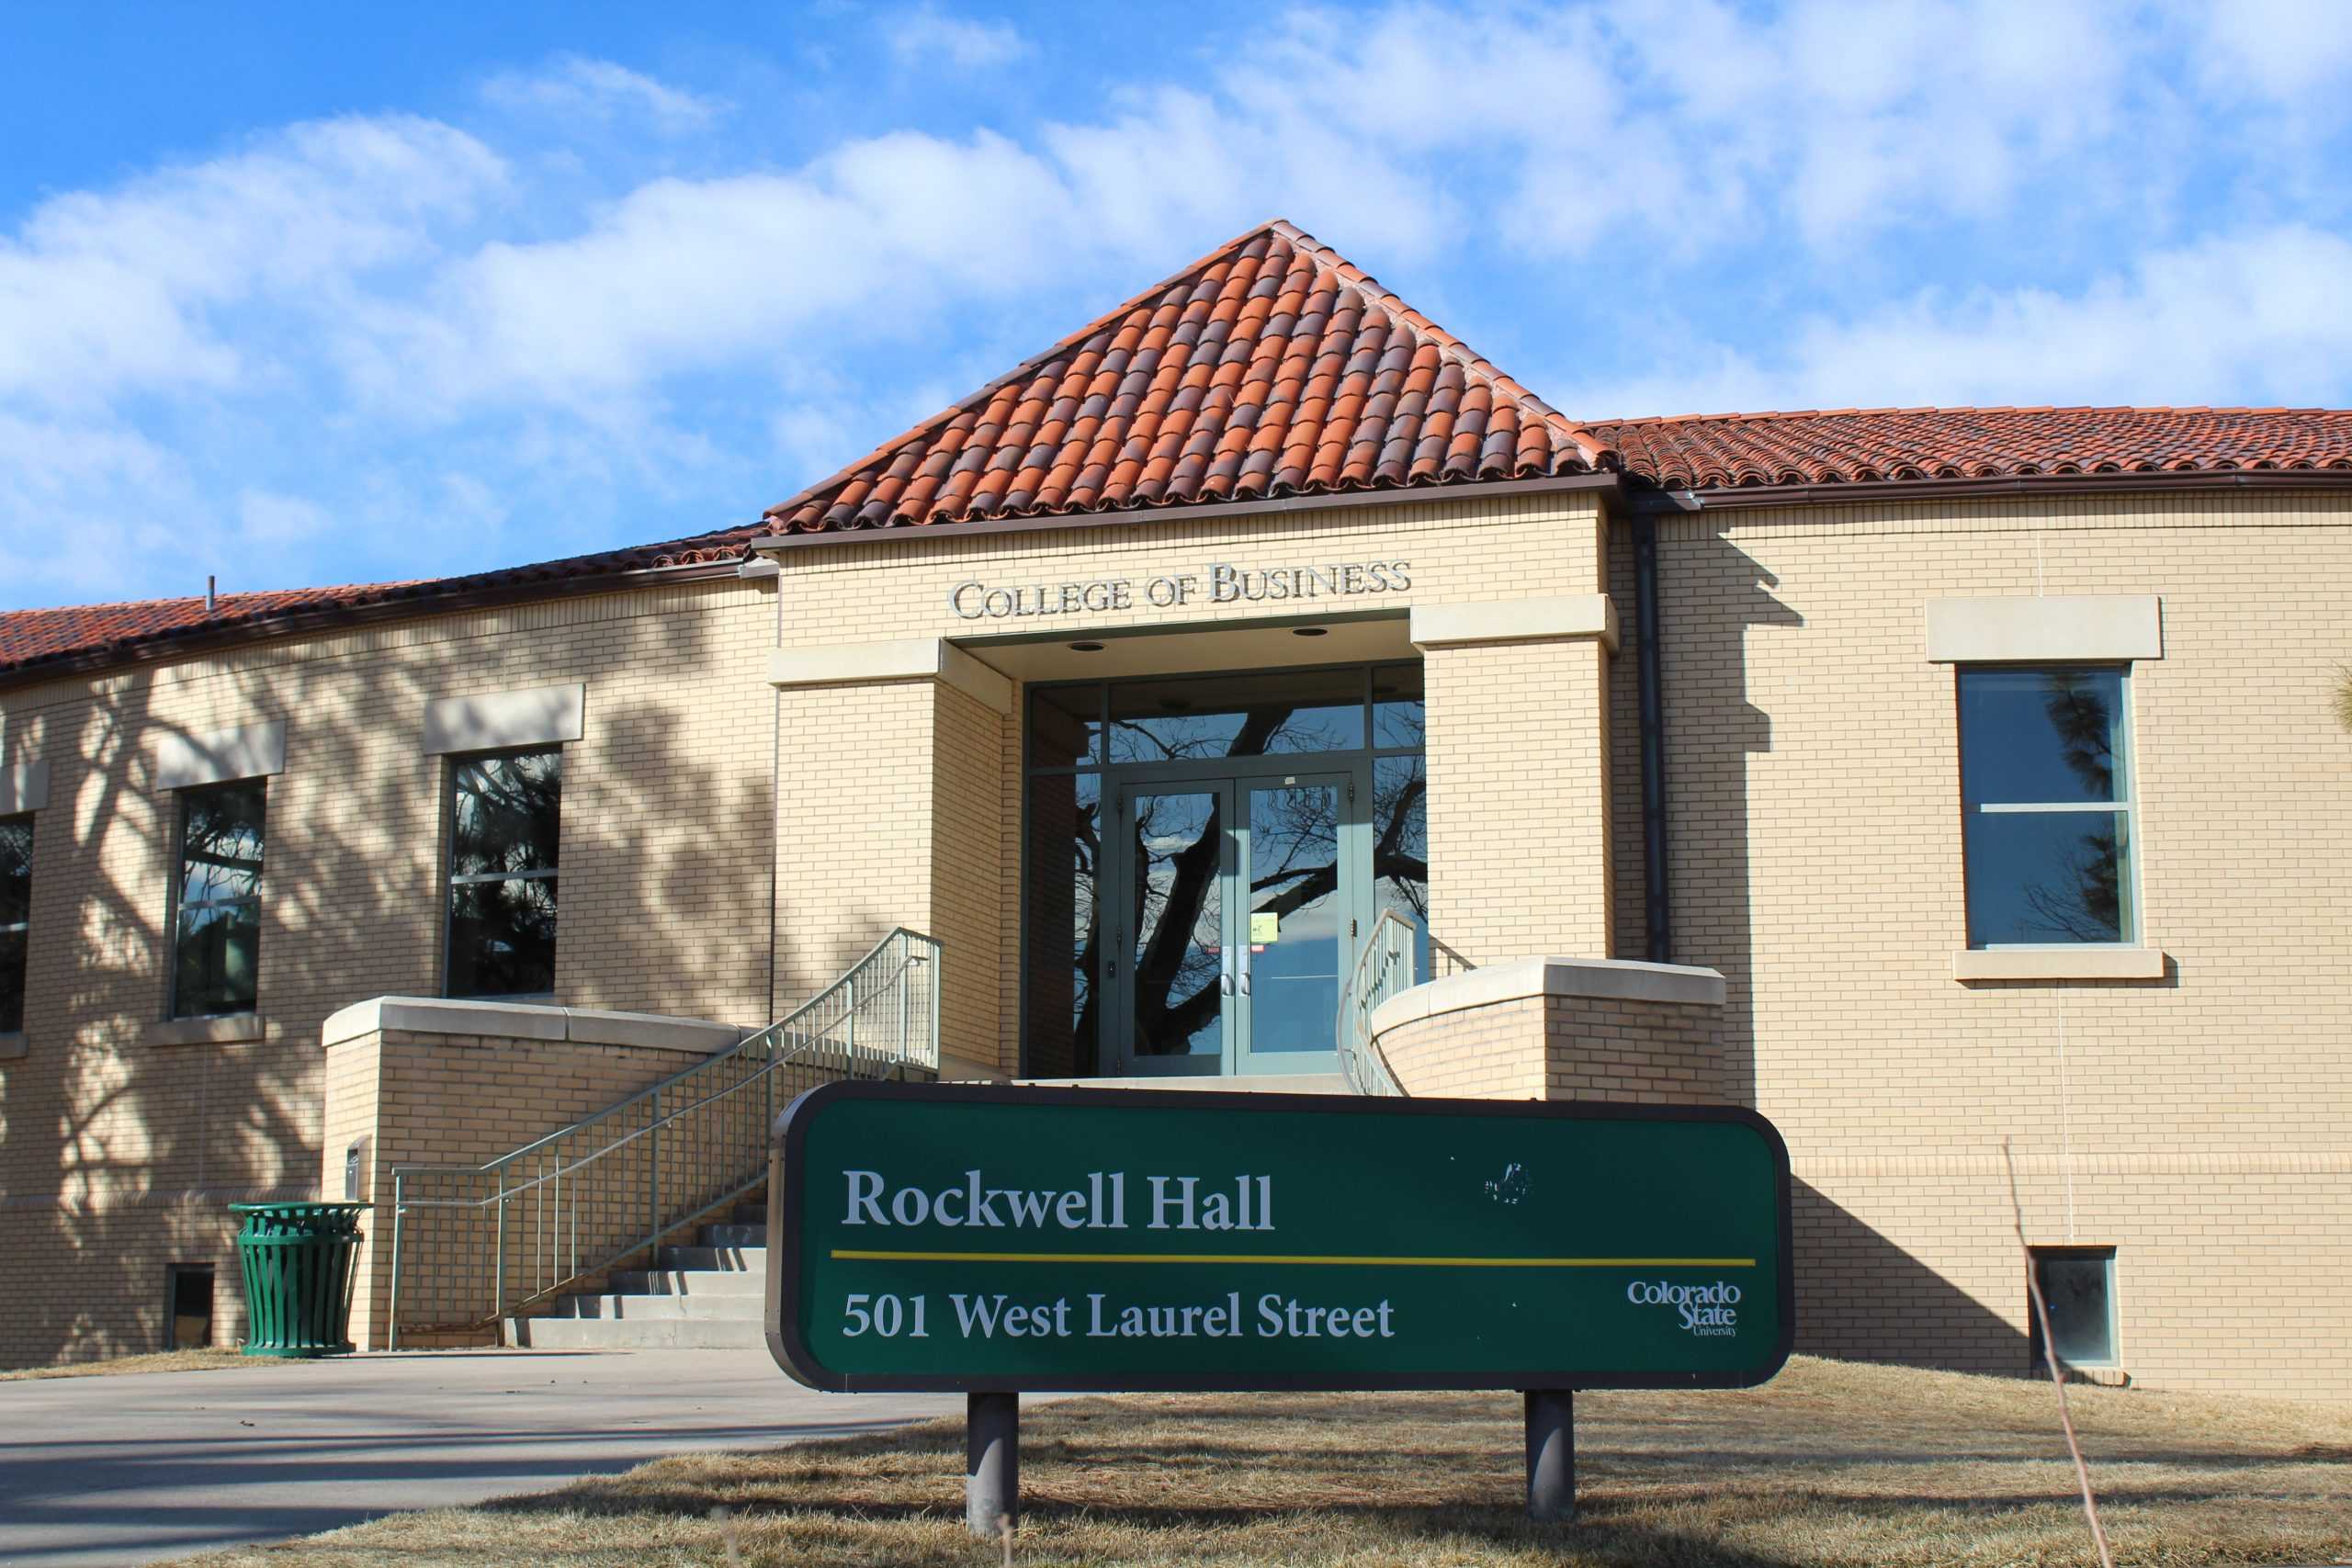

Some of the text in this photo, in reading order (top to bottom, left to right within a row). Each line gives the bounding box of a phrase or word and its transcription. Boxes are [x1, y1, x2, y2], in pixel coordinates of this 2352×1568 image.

[949, 580, 1133, 619] COLLEGE
[1205, 558, 1412, 603] BUSINESS
[841, 1169, 1276, 1231] Rockwell Hall
[1627, 1280, 1742, 1304] Colorado
[842, 1292, 1396, 1339] 501 West Laurel Street
[1678, 1301, 1737, 1330] State
[1693, 1325, 1736, 1337] University
